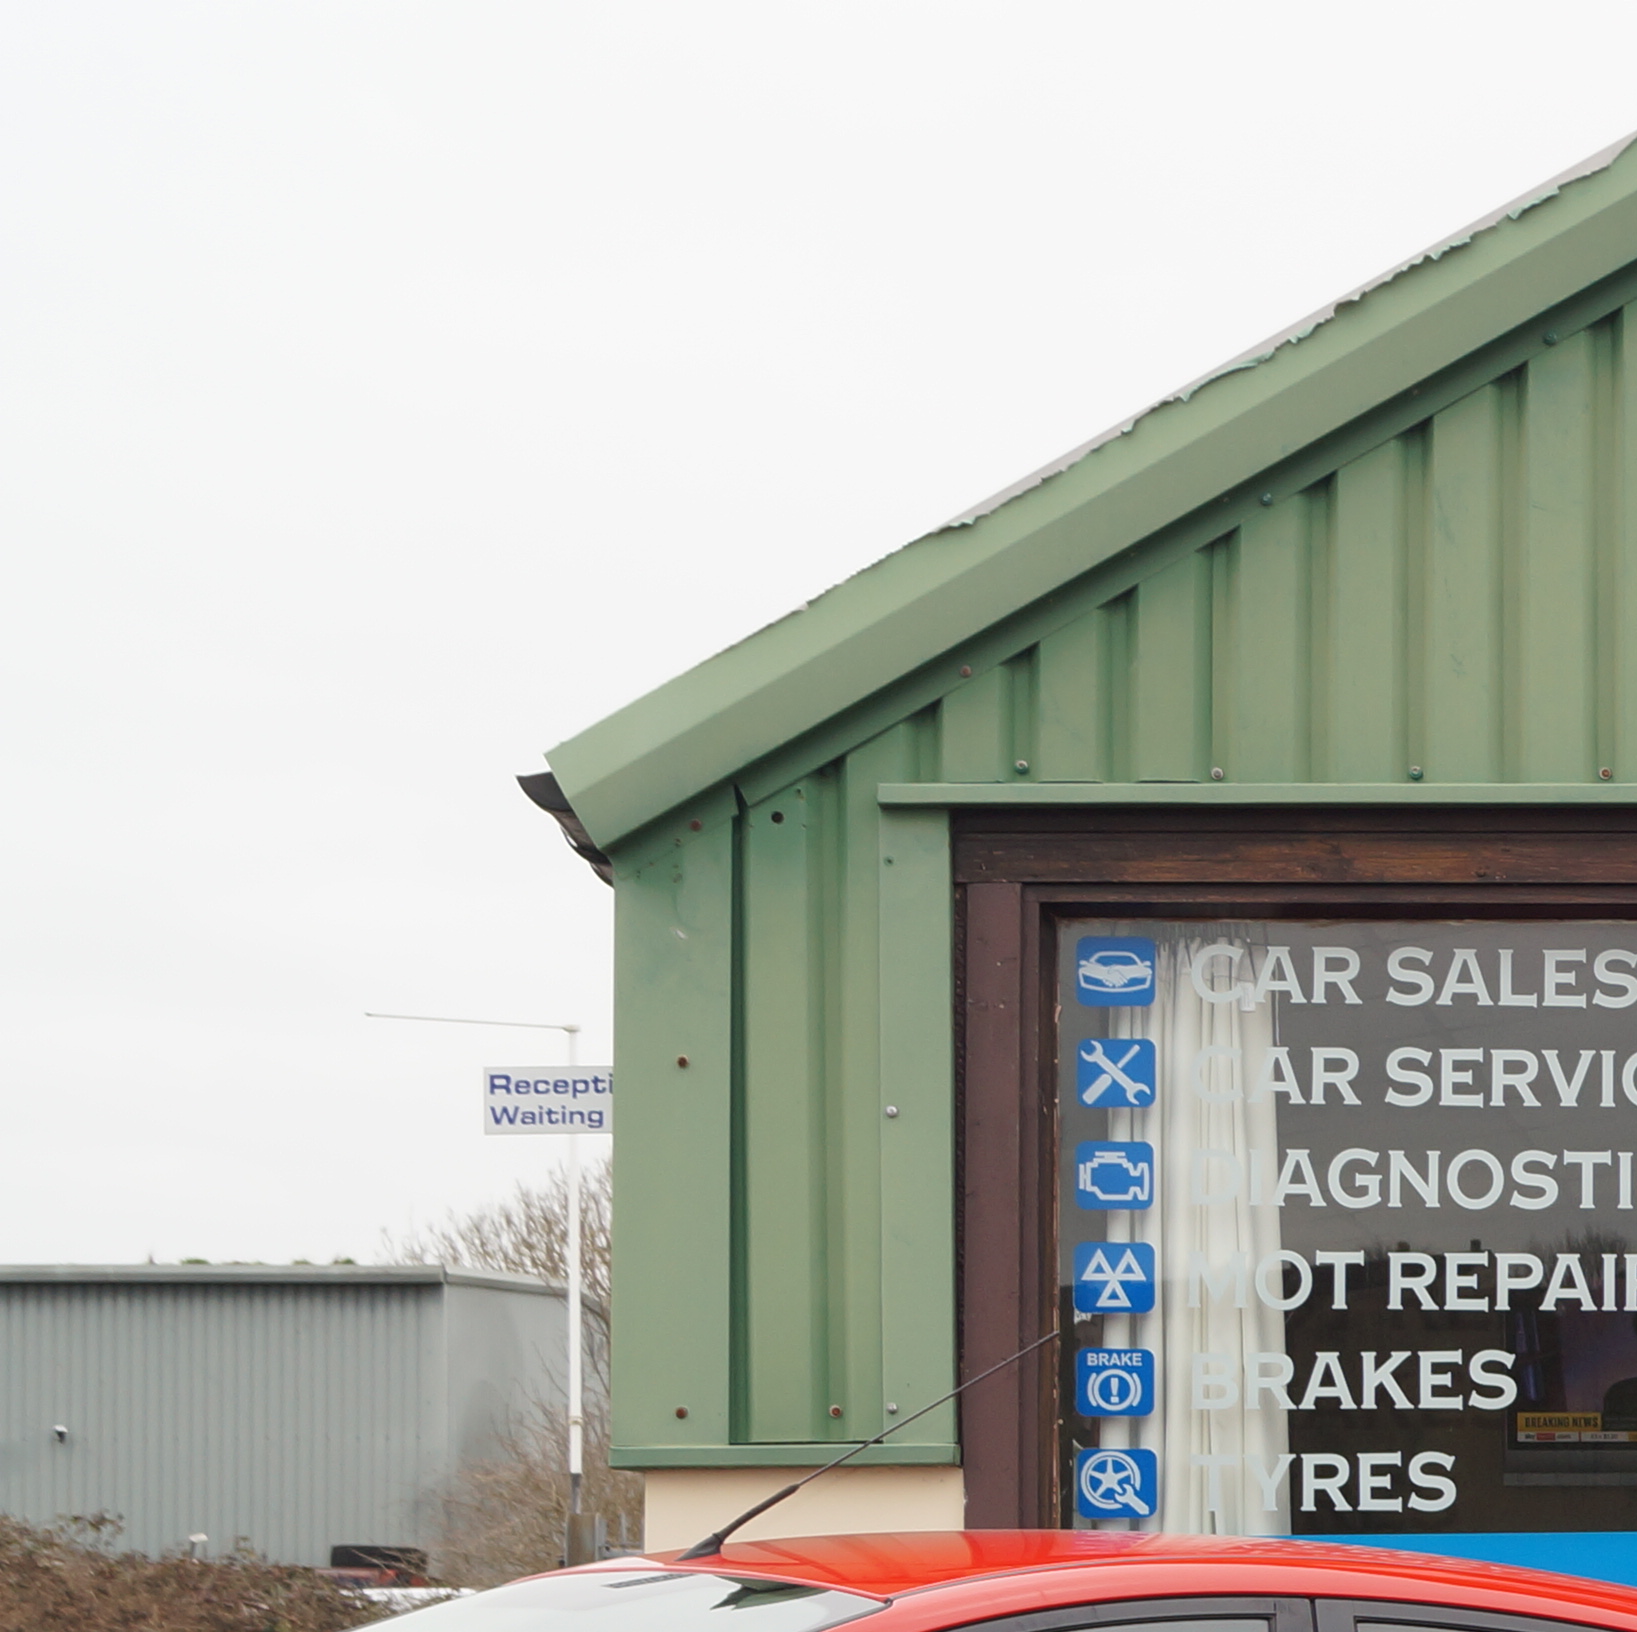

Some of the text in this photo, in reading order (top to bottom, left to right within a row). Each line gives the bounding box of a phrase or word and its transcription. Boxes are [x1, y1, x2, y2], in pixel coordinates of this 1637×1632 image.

[1190, 944, 1364, 1005] CAR
[489, 1073, 613, 1099] Recepti
[1189, 1045, 1363, 1105] CAR
[490, 1105, 604, 1128] Waiting
[1187, 1249, 1365, 1312] MOT
[1086, 1352, 1143, 1367] BRAKE
[1191, 1349, 1518, 1411] BRAKES
[1524, 1416, 1571, 1428] BREAKING
[1571, 1416, 1599, 1428] NEWS
[1190, 1450, 1457, 1513] TYRES
